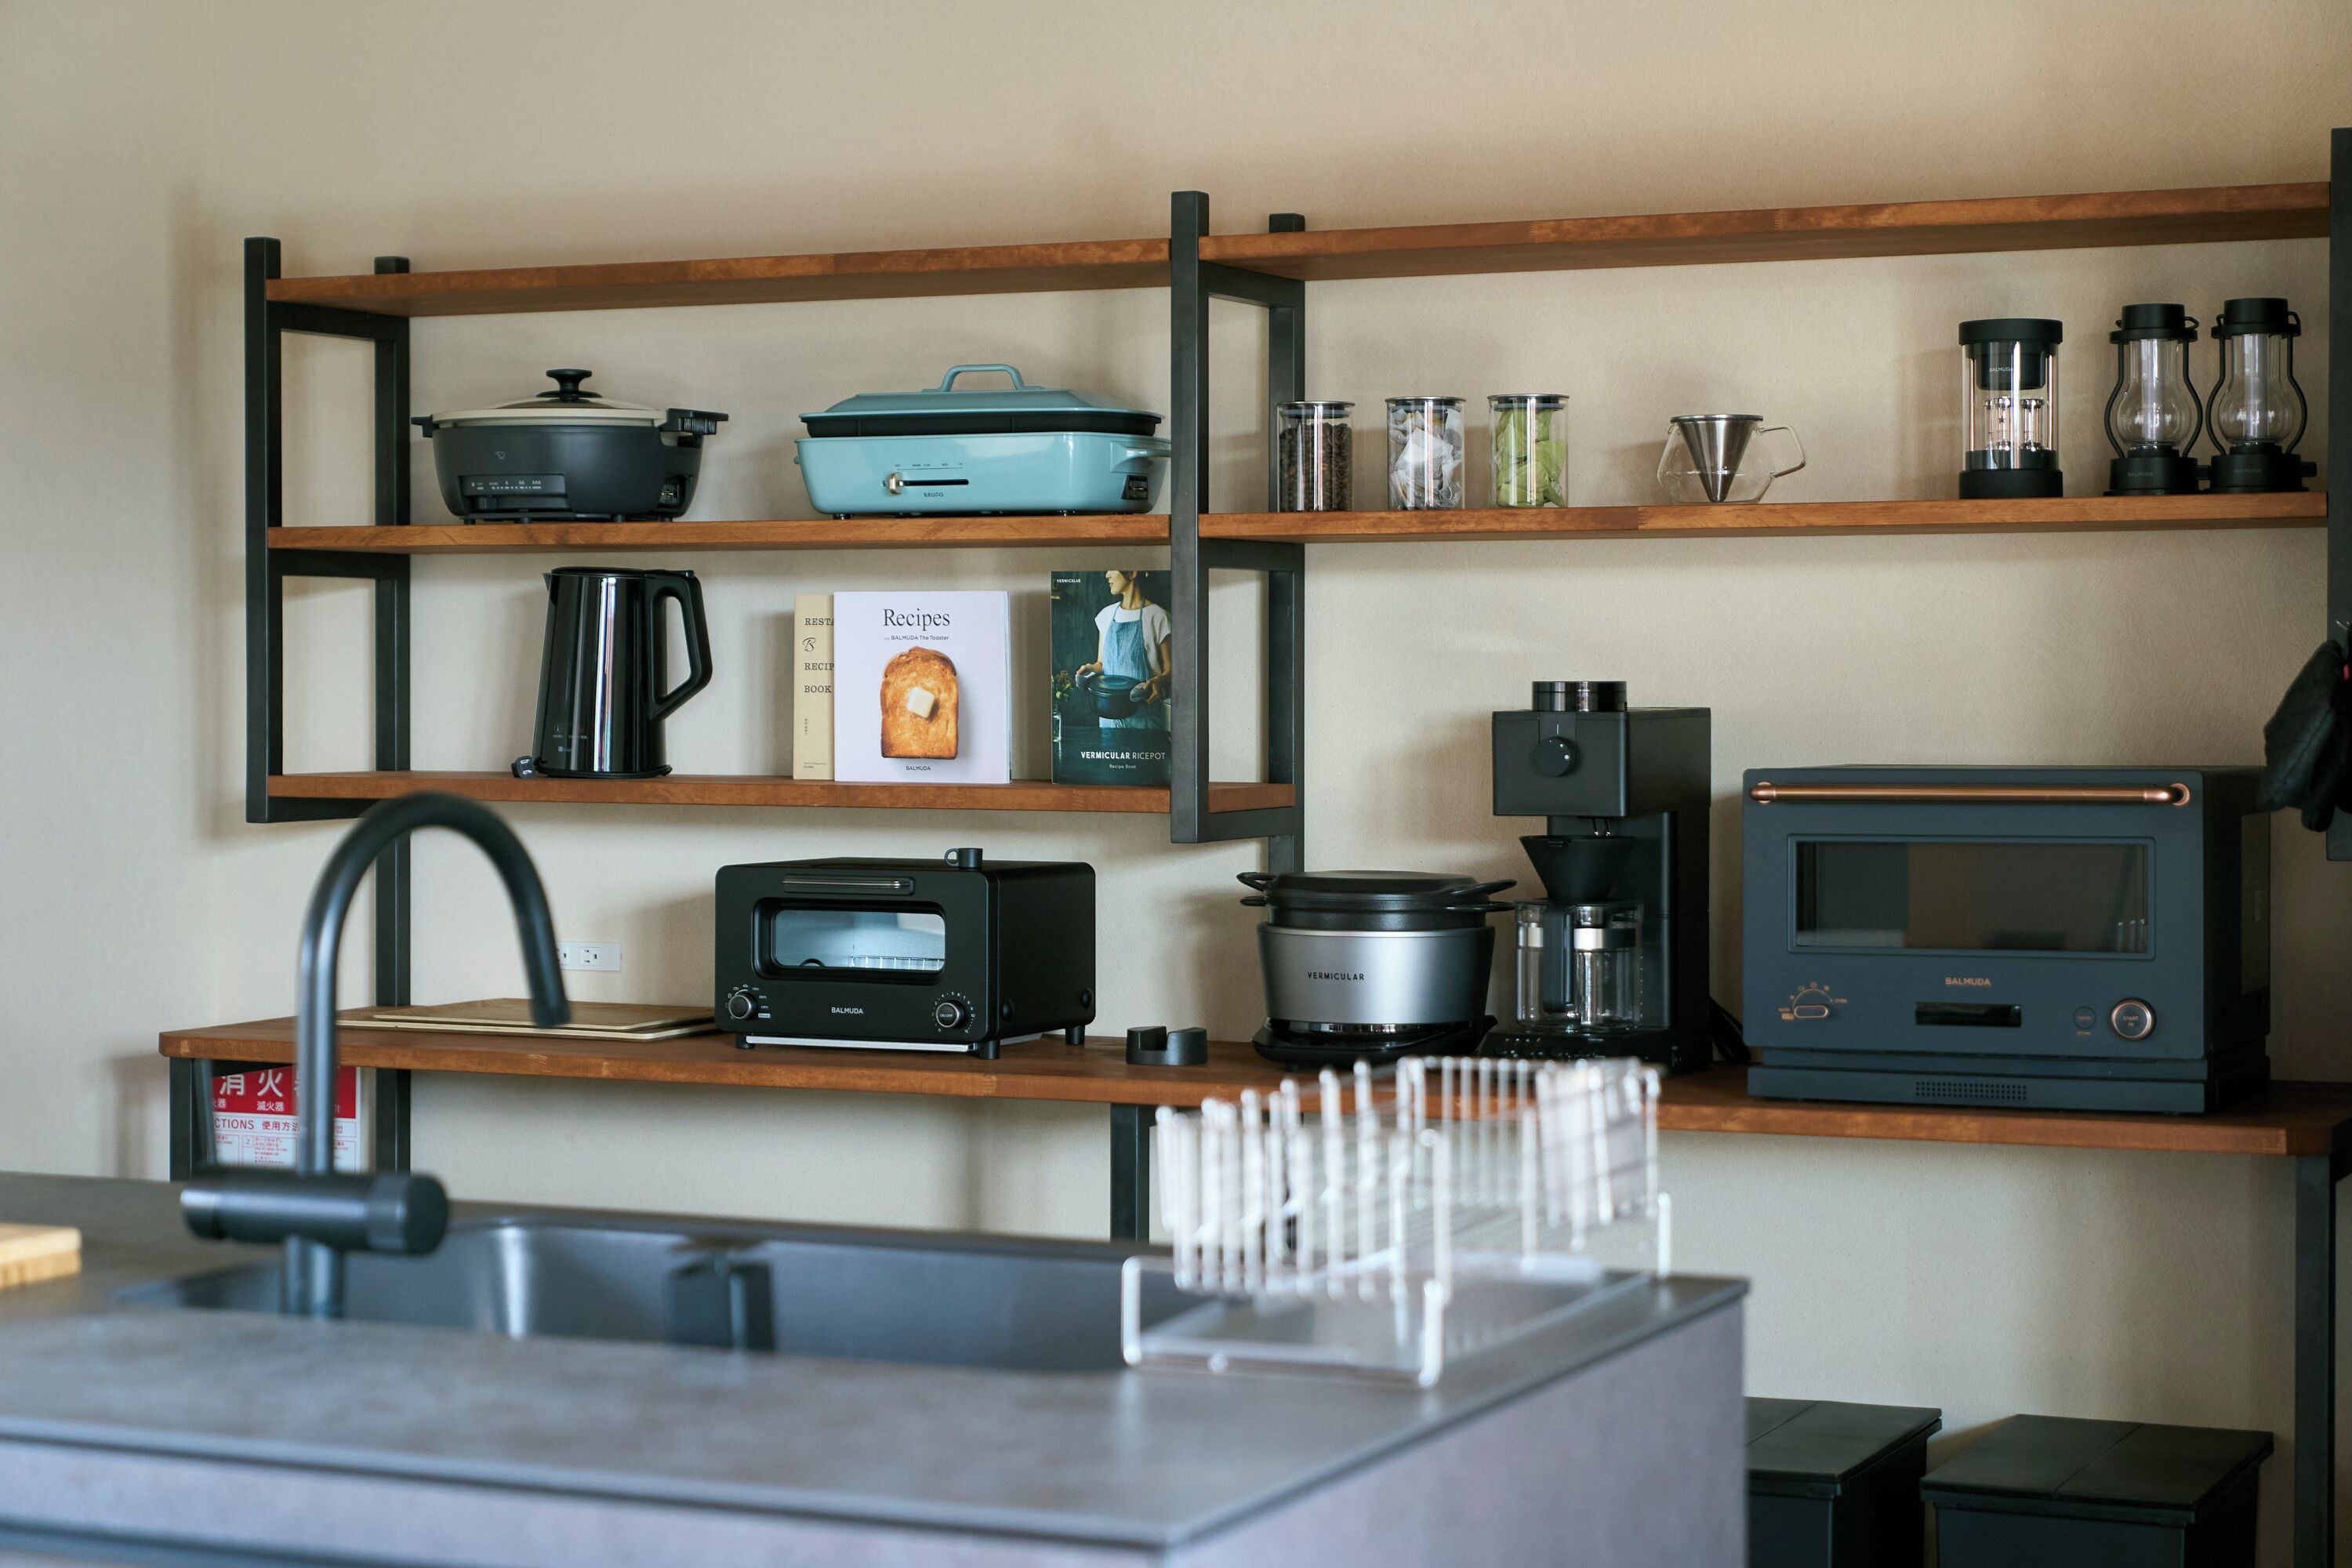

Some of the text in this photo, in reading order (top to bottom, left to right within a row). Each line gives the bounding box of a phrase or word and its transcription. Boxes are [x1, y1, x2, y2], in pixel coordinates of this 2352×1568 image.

[883, 608, 950, 631] Recipes
[1307, 972, 1365, 981] VERMICULAR
[1945, 977, 1991, 985] BALMUDA
[220, 1069, 300, 1098] 消火
